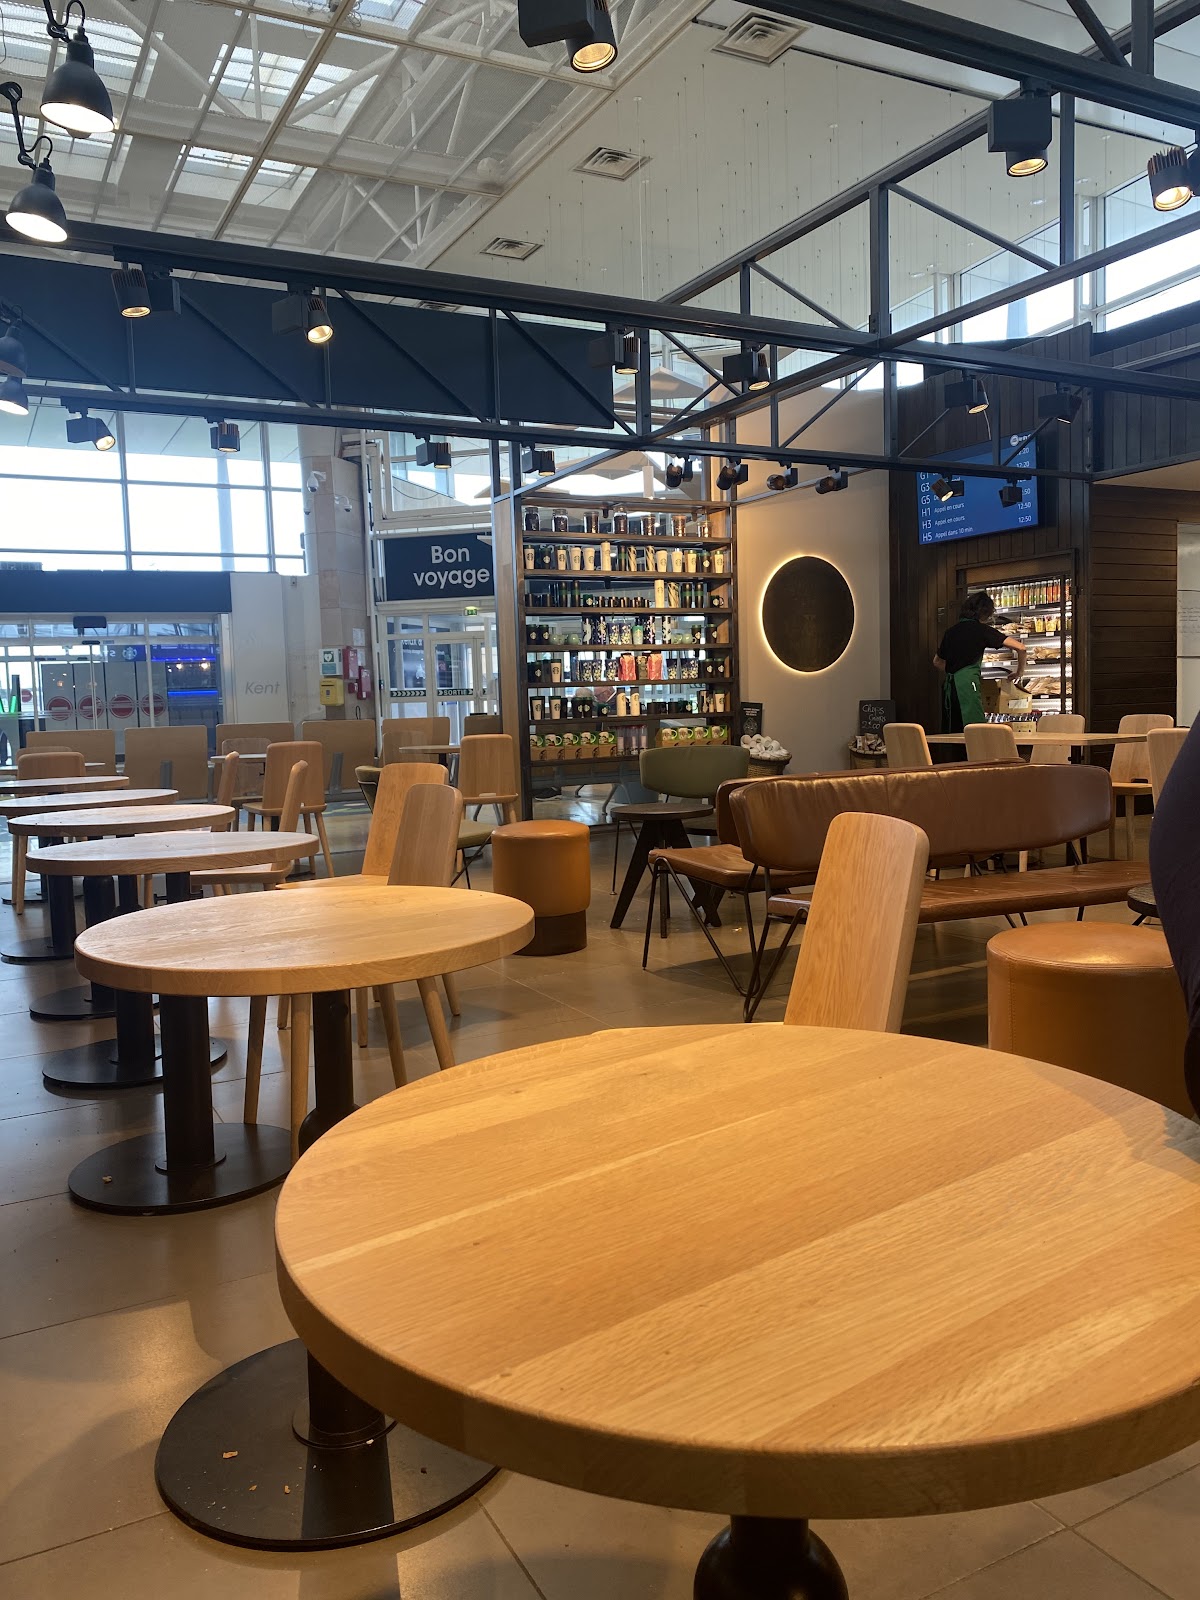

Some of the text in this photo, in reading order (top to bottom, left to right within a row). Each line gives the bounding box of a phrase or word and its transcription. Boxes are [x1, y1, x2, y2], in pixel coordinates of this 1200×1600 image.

[920, 482, 930, 493] G3
[921, 495, 931, 505] G5
[921, 507, 931, 518] H1
[934, 505, 946, 514] Appel
[922, 519, 932, 530] H3
[934, 518, 947, 527] Appel
[1017, 501, 1032, 510] 12:50
[922, 531, 933, 542] H5
[934, 531, 948, 539] Appel
[1018, 515, 1032, 523] 12:50
[430, 545, 470, 564] Bon
[412, 567, 490, 589] voyage
[244, 681, 281, 695] Kent
